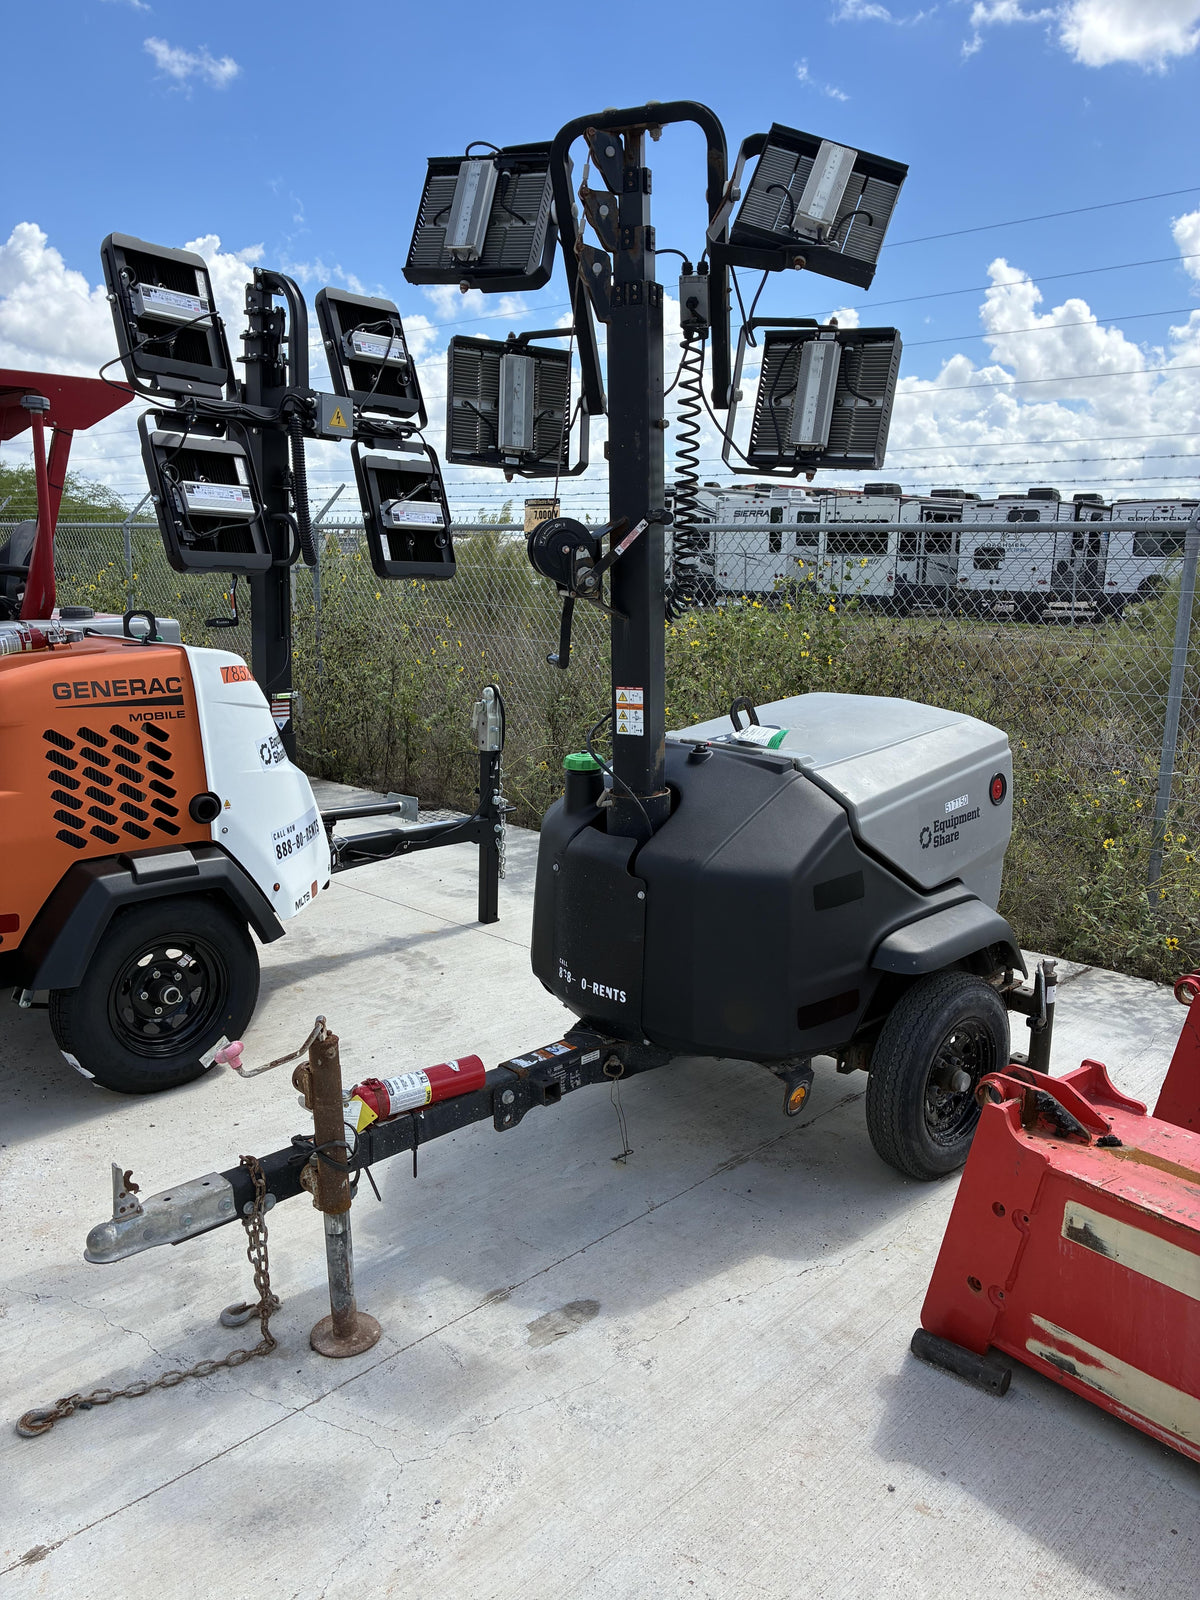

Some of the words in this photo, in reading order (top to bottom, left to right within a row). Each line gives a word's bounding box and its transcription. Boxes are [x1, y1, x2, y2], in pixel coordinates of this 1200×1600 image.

[733, 509, 769, 517] SIERRA
[52, 677, 183, 700] GENERAC
[128, 710, 185, 722] MOBILE
[933, 806, 980, 833] Equipment
[273, 829, 285, 840] CALL
[287, 823, 295, 835] NOW
[275, 819, 319, 860] 888-80-RENTS
[933, 830, 959, 848] Share
[295, 891, 311, 910] MLTS
